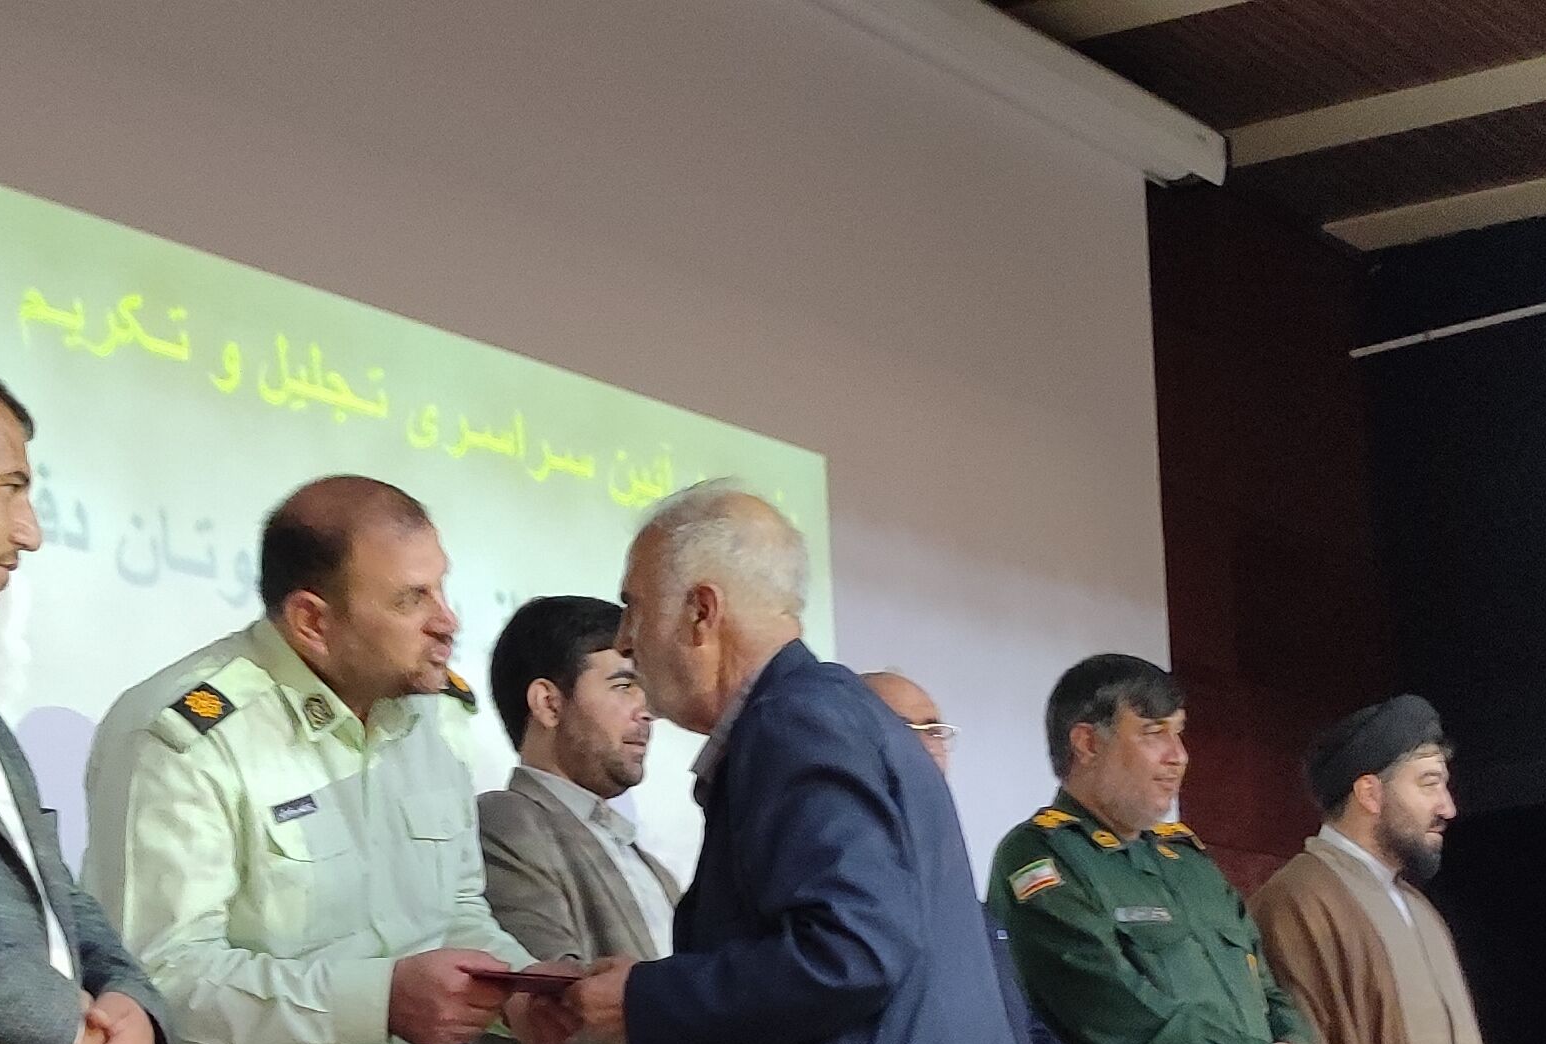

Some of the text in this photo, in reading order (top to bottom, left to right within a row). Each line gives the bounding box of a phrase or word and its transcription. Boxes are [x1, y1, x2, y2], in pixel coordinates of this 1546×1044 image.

[18, 287, 191, 361] تکریم
[210, 341, 241, 393] و
[259, 332, 388, 424] تجلیل
[407, 403, 595, 482] سراسری
